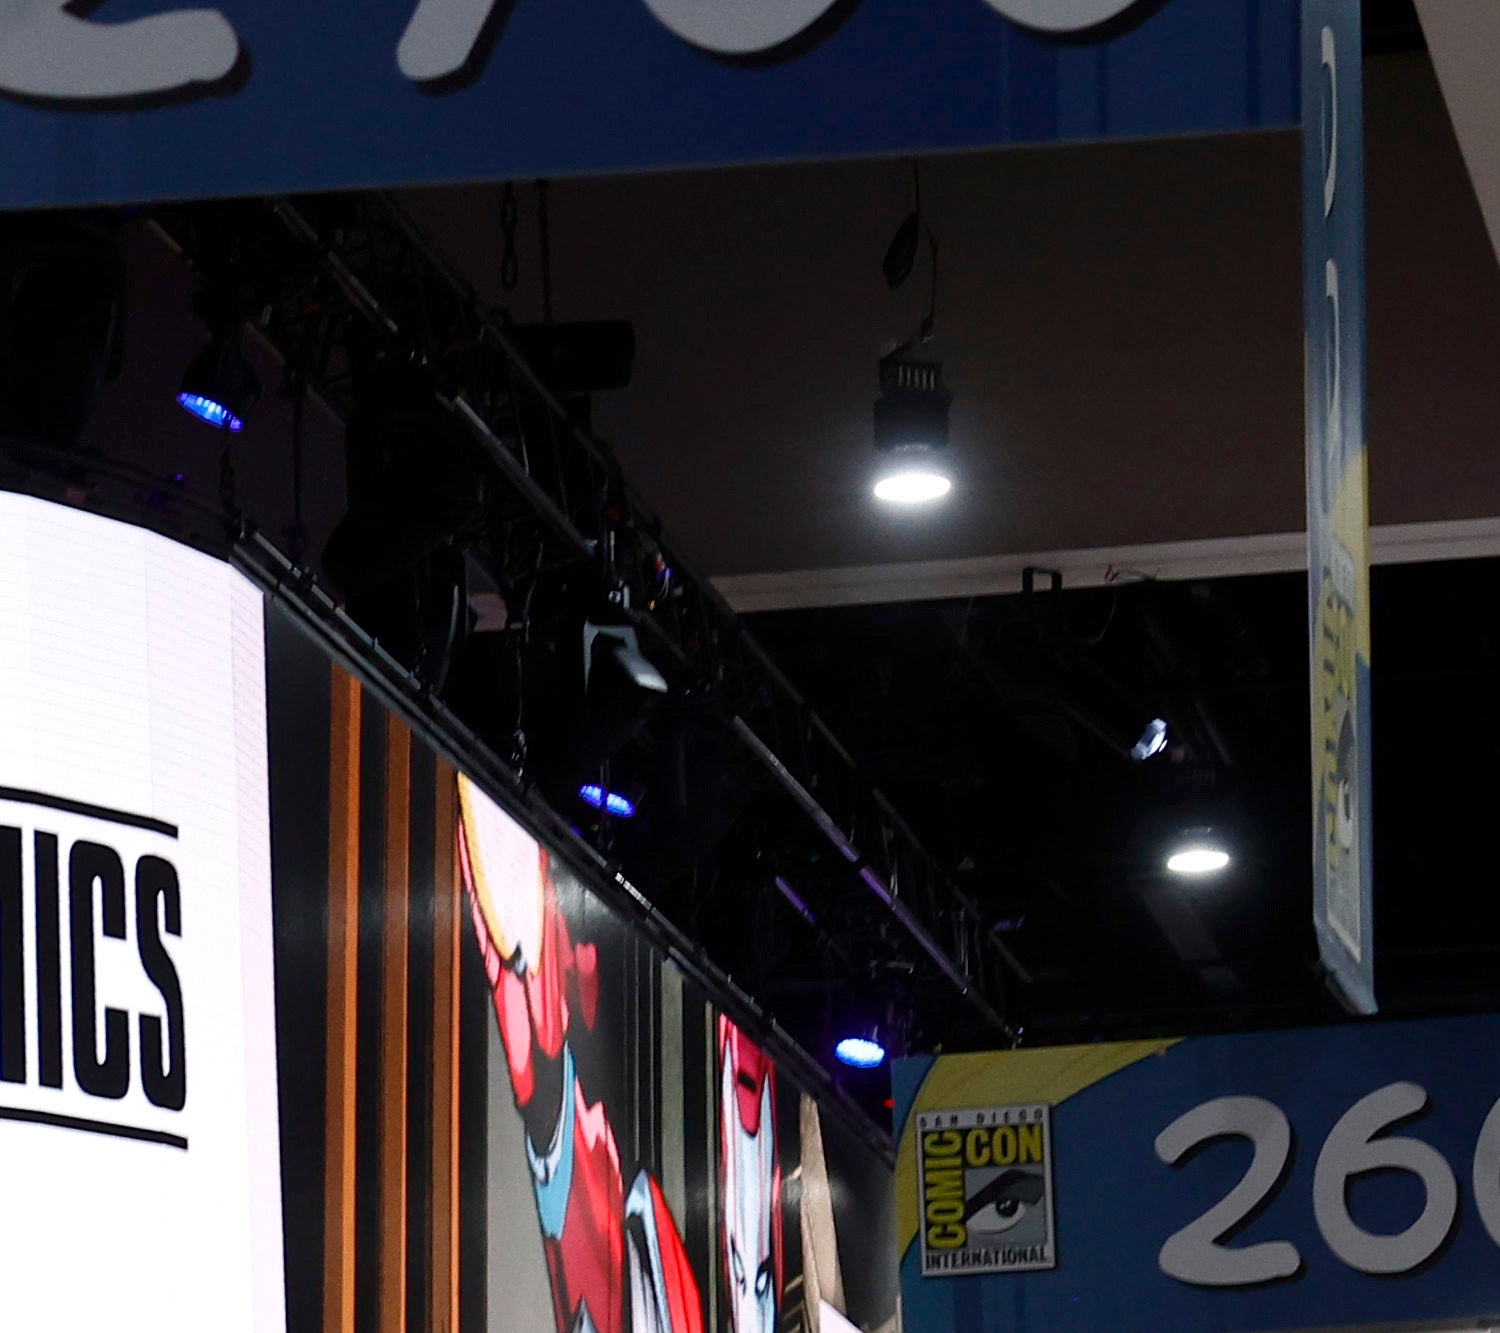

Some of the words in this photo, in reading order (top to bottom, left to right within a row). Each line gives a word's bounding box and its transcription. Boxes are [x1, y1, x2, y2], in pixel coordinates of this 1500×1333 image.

[965, 1123, 1044, 1168] CON
[923, 1130, 968, 1249] COMIC
[925, 1247, 1048, 1270] INTERNATIONAL
